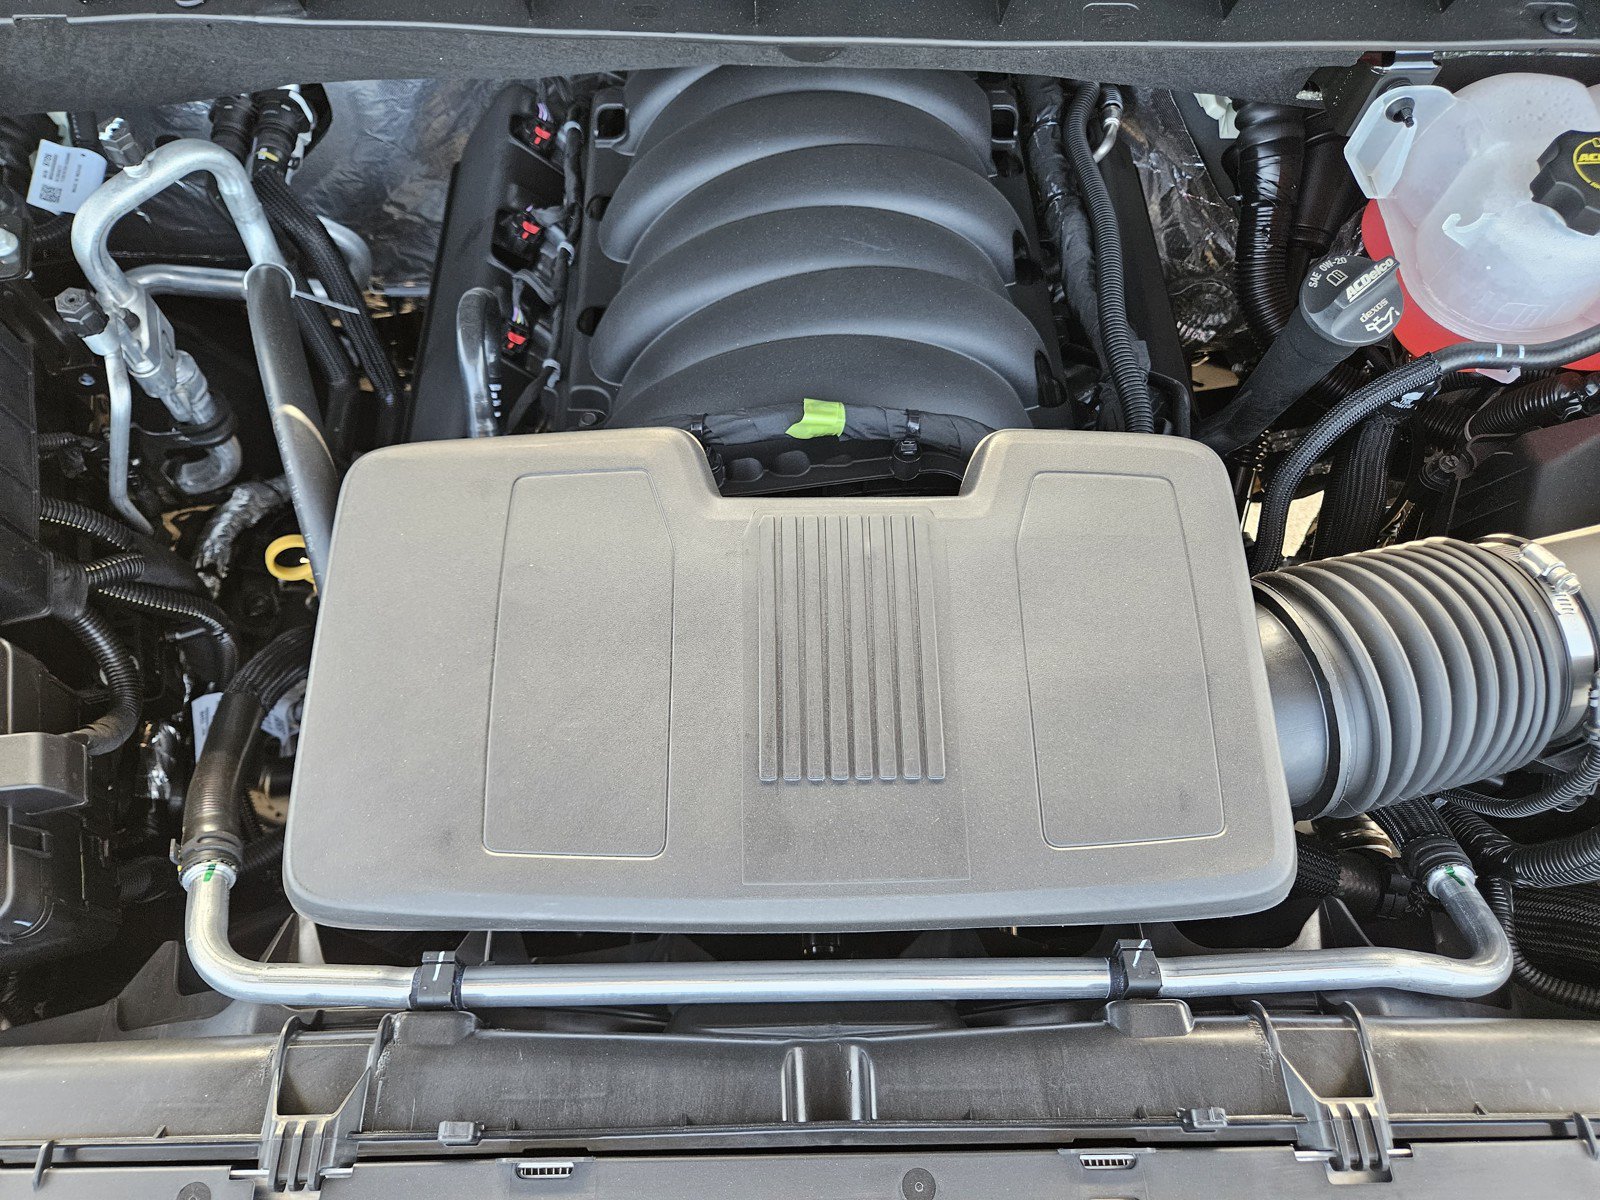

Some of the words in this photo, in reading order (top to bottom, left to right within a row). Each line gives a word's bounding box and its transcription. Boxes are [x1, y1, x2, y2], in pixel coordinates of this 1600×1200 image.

[1577, 152, 1600, 161] AC
[1308, 271, 1322, 288] SAE
[1319, 256, 1347, 272] 0W-20
[1346, 258, 1394, 300] ACDelco
[1359, 298, 1389, 323] dexos
